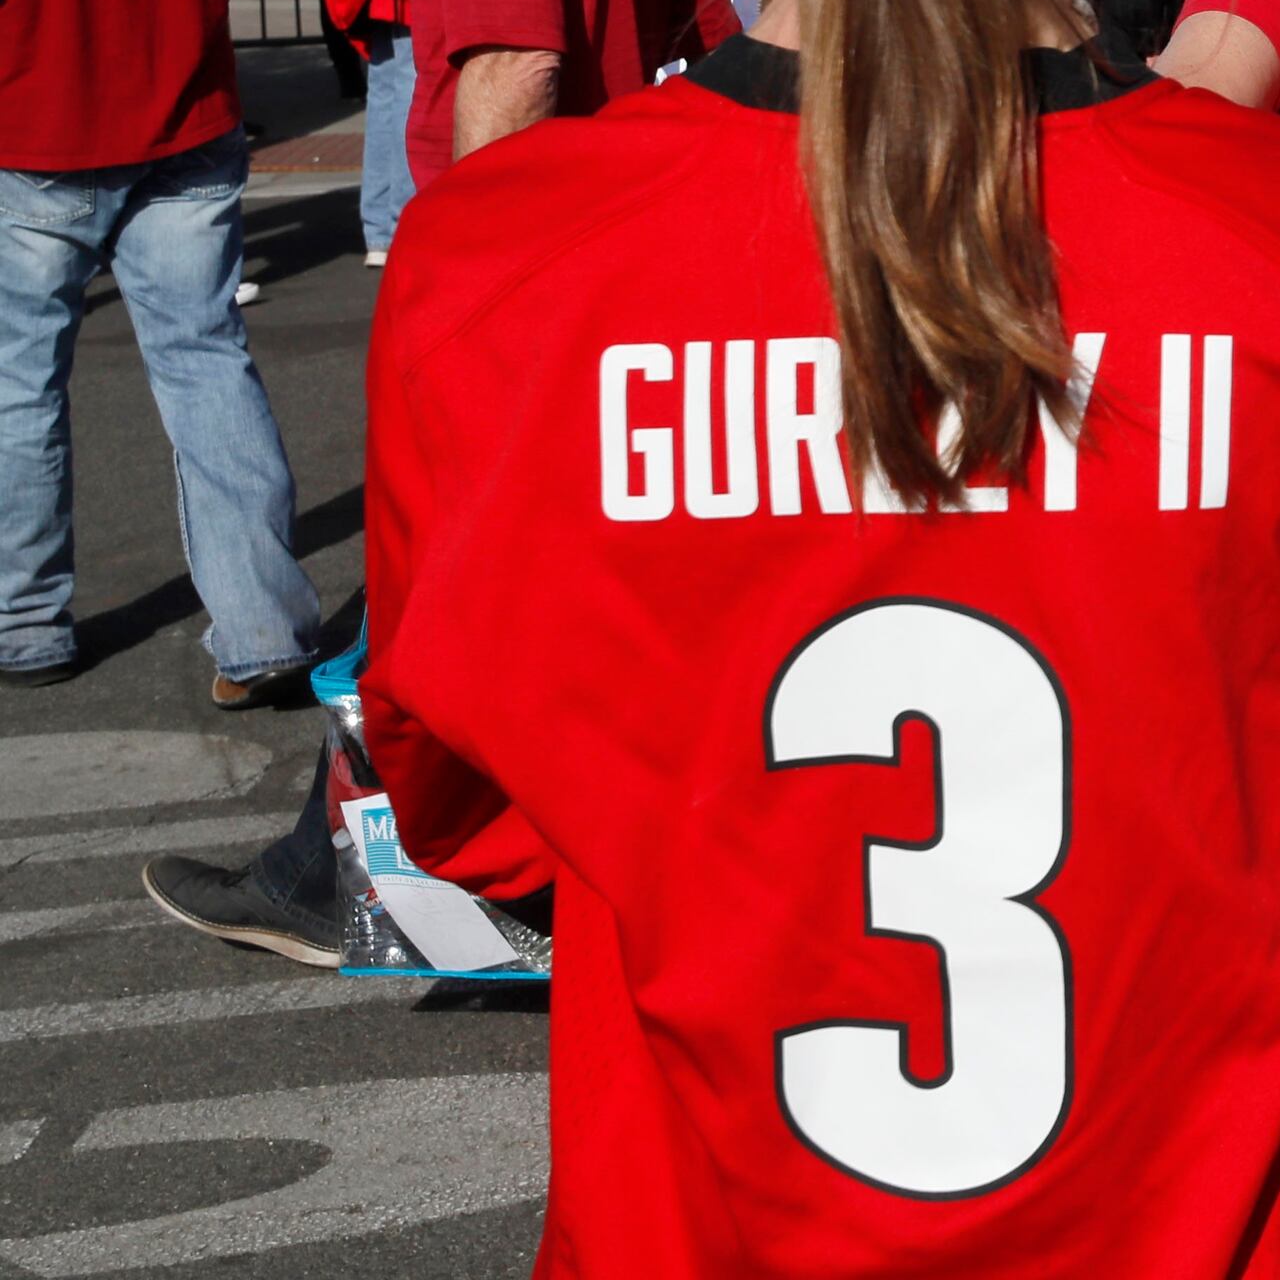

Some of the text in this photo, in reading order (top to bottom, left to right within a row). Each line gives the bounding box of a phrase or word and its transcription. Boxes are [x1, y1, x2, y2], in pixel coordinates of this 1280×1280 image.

[599, 332, 1233, 522] GURY II
[765, 595, 1072, 1200] 3
